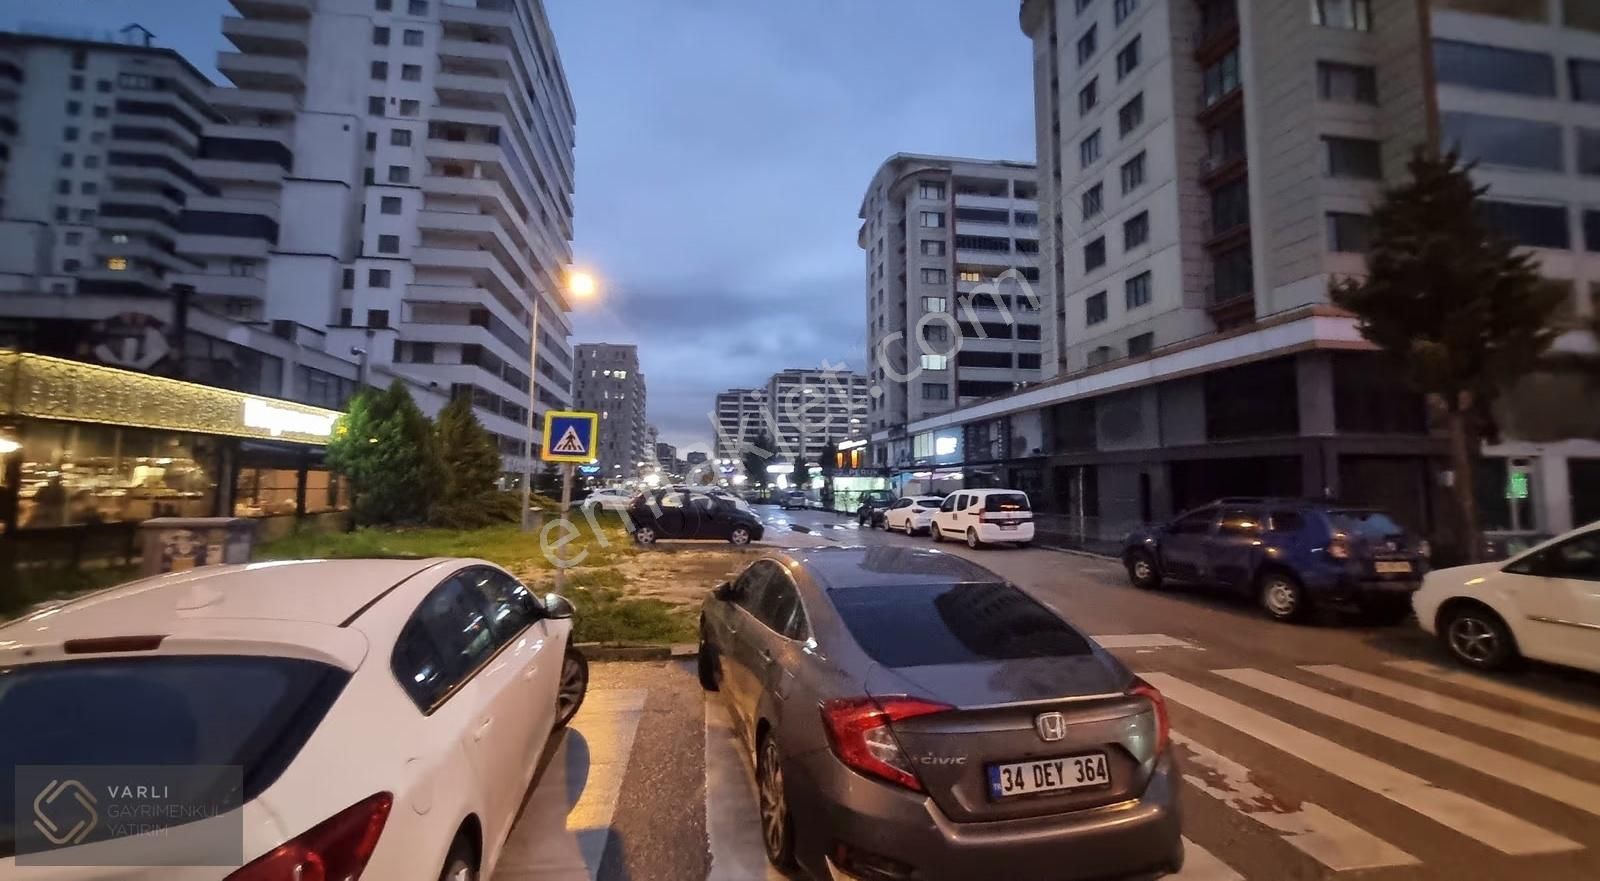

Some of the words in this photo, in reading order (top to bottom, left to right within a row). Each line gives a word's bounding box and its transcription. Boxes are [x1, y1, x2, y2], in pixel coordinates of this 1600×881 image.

[1003, 766, 1024, 792] 34
[1032, 762, 1064, 787] DEY
[1074, 757, 1106, 784] 364
